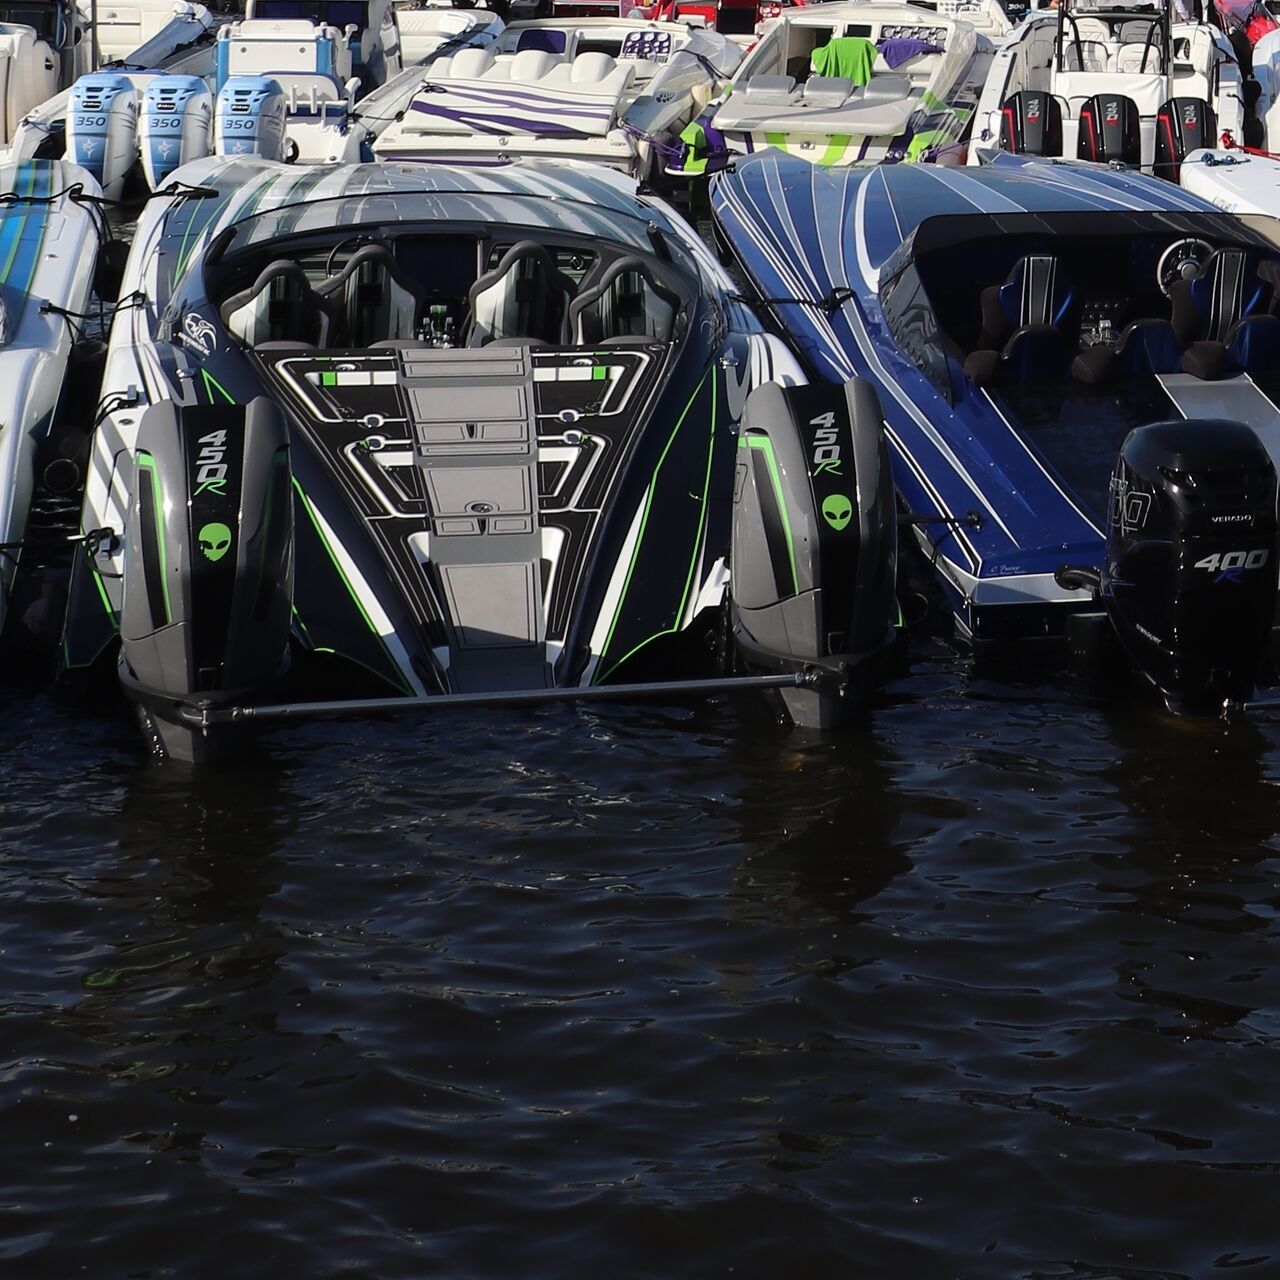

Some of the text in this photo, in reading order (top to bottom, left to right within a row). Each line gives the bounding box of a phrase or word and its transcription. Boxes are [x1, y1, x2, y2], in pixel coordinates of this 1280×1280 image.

[75, 116, 106, 127] 350
[151, 118, 181, 128] 350
[224, 119, 254, 130] 350
[1211, 514, 1252, 523] VERADO
[1194, 548, 1269, 573] 400
